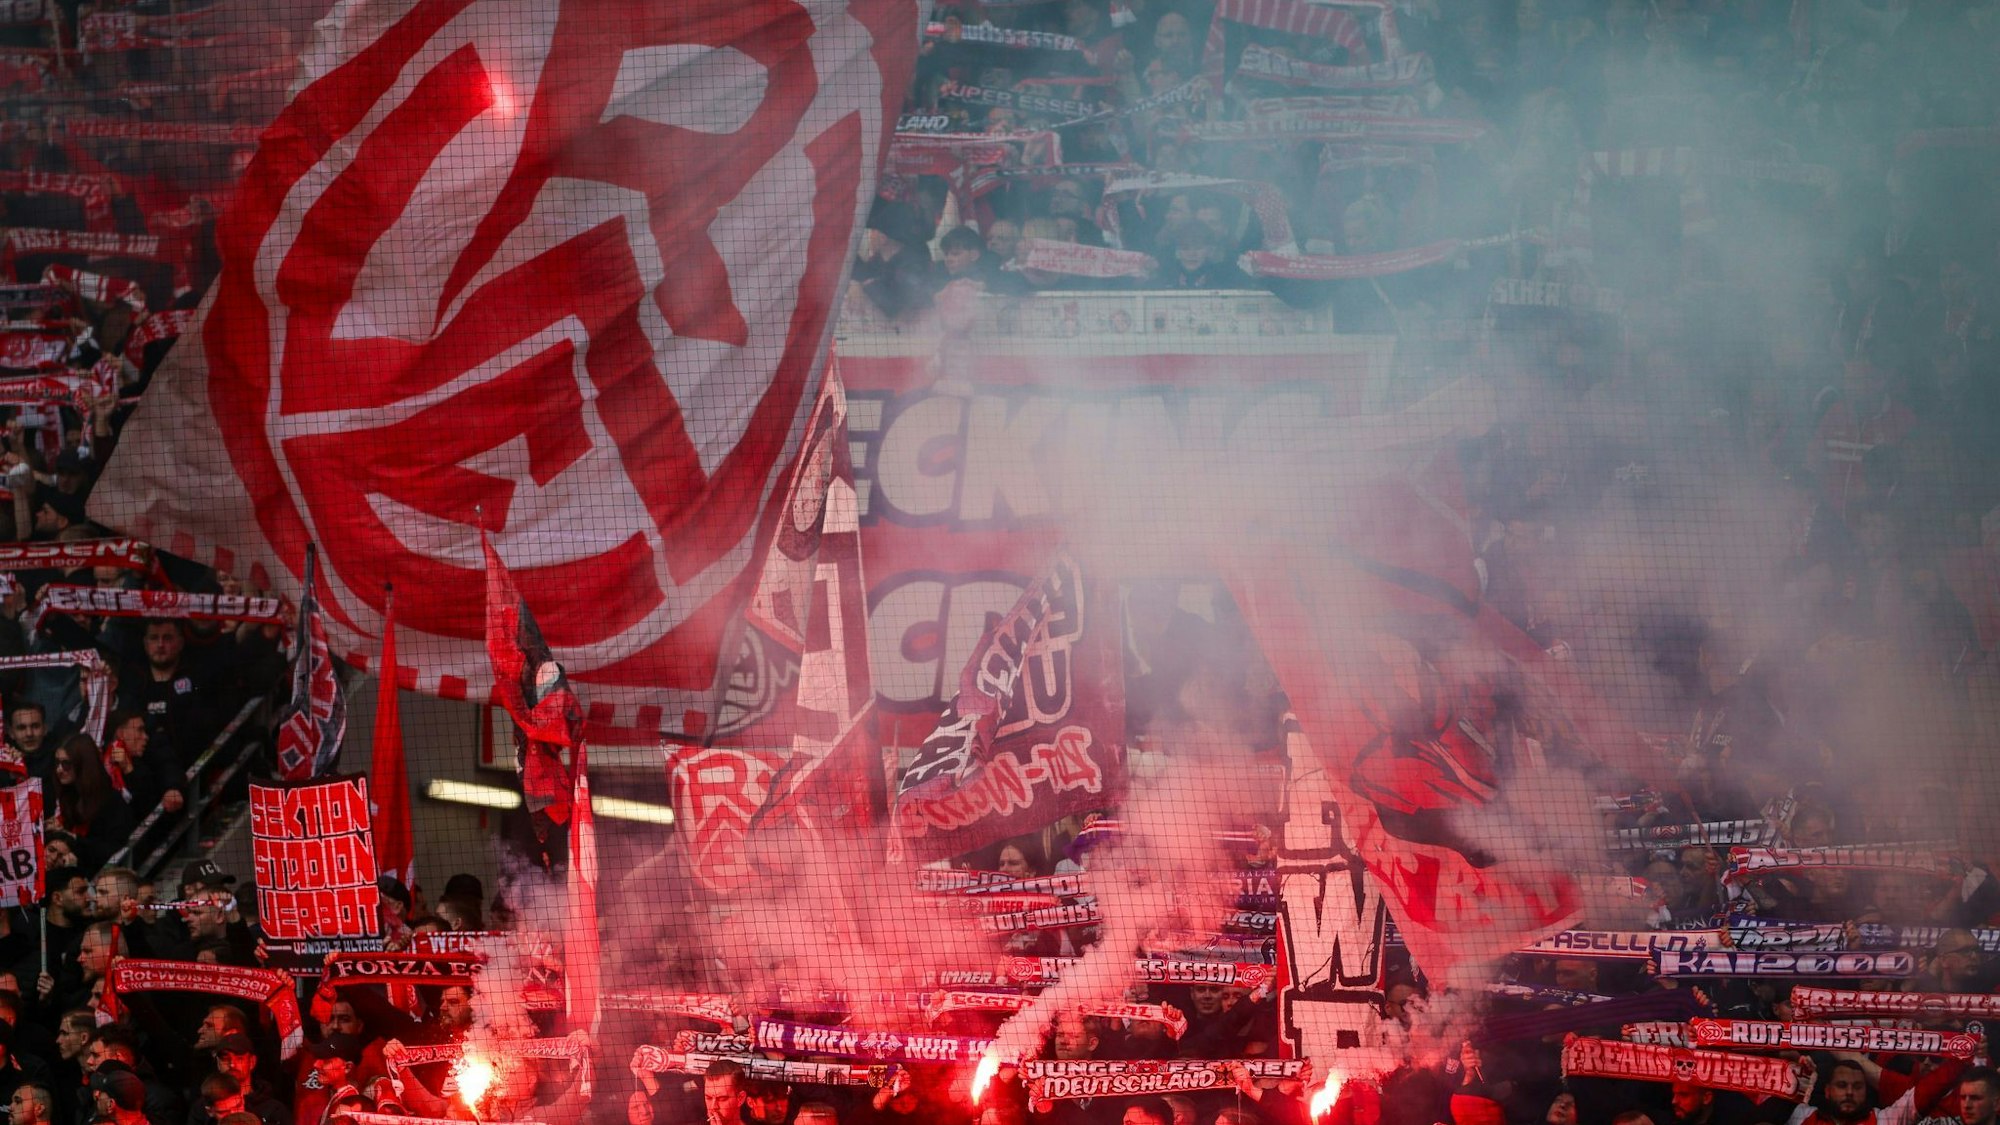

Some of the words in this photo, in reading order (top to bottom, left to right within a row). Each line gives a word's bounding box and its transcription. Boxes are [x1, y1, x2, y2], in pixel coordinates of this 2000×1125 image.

[948, 85, 1012, 102] UPER
[1019, 96, 1094, 116] ESSEN
[249, 777, 372, 839] SEKTION
[253, 830, 378, 890] STADION
[257, 884, 380, 942] VERBOT
[980, 902, 1103, 932] ROT-WEISS
[343, 939, 384, 955] ULTRAS
[121, 969, 213, 985] Rot-Weiss
[217, 974, 270, 993] Essen
[333, 960, 442, 979] FORZA
[939, 970, 993, 985] IMMER
[1168, 960, 1238, 985] ESSEN
[758, 1020, 785, 1049] IN
[794, 1025, 858, 1056] WIEN
[904, 1036, 959, 1061] NUR
[1732, 1022, 1865, 1050] ROT-WEISS
[1868, 1028, 1943, 1052] ESSEN
[1027, 1060, 1128, 1079] JUNGE
[1567, 1040, 1672, 1078] FREAKS
[1693, 1050, 1800, 1095] ULTRAS
